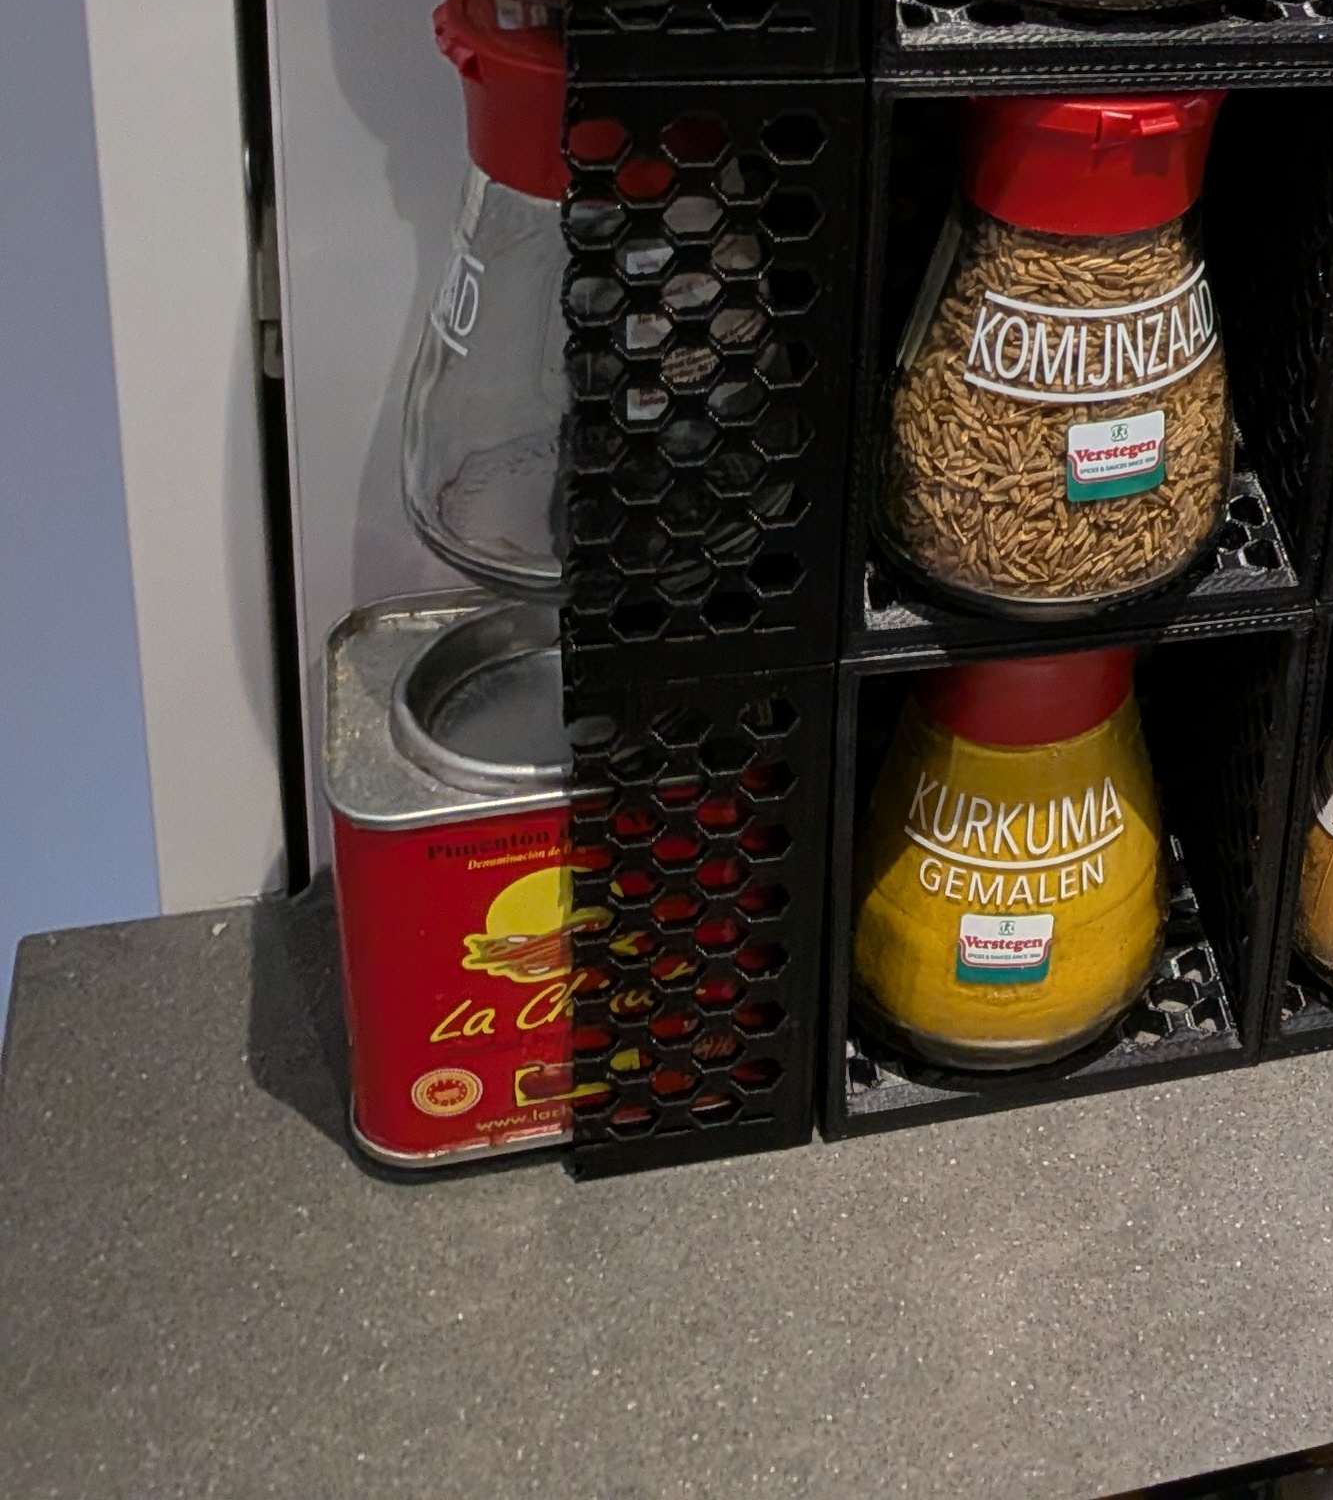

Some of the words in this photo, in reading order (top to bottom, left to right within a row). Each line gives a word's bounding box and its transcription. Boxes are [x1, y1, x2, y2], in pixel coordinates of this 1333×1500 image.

[967, 279, 1215, 387] KOMIJNZAAD
[1074, 437, 1157, 464] Verstegen
[908, 771, 1123, 856] KURKUMA
[427, 830, 550, 860] Pimentón
[919, 853, 1105, 906] GEMALEN
[965, 934, 1044, 953] Verstegen
[430, 1000, 496, 1042] La
